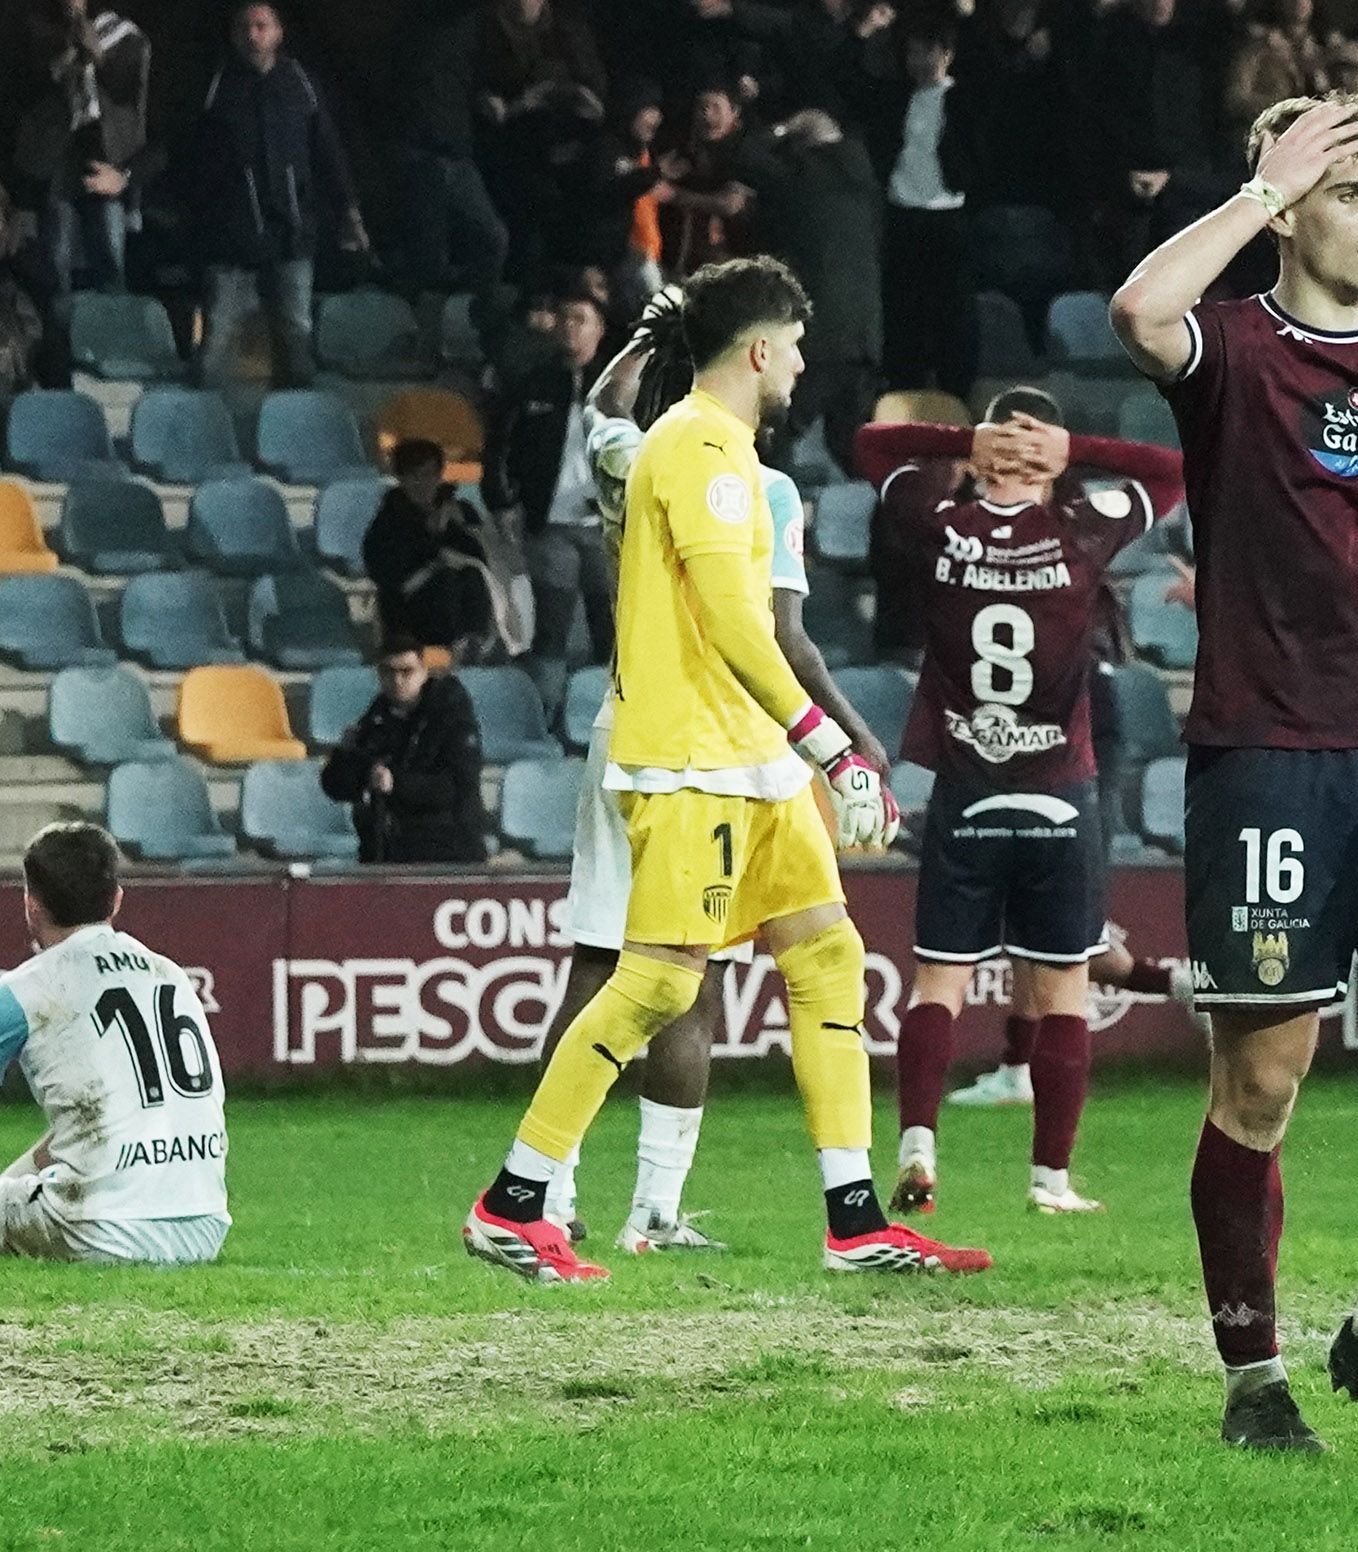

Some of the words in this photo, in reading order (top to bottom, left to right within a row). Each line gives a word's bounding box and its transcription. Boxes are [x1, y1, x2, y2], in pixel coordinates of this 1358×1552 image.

[935, 556, 957, 585] B.
[962, 562, 1072, 592] ABELENDA
[970, 602, 1035, 706] 8
[711, 822, 733, 878] 1
[1238, 827, 1305, 904] 16
[1250, 907, 1289, 919] XUNTA
[1250, 919, 1265, 930] DE
[1267, 917, 1311, 930] GALICIA
[90, 984, 214, 1109] 16
[116, 1134, 227, 1171] //ABANC
